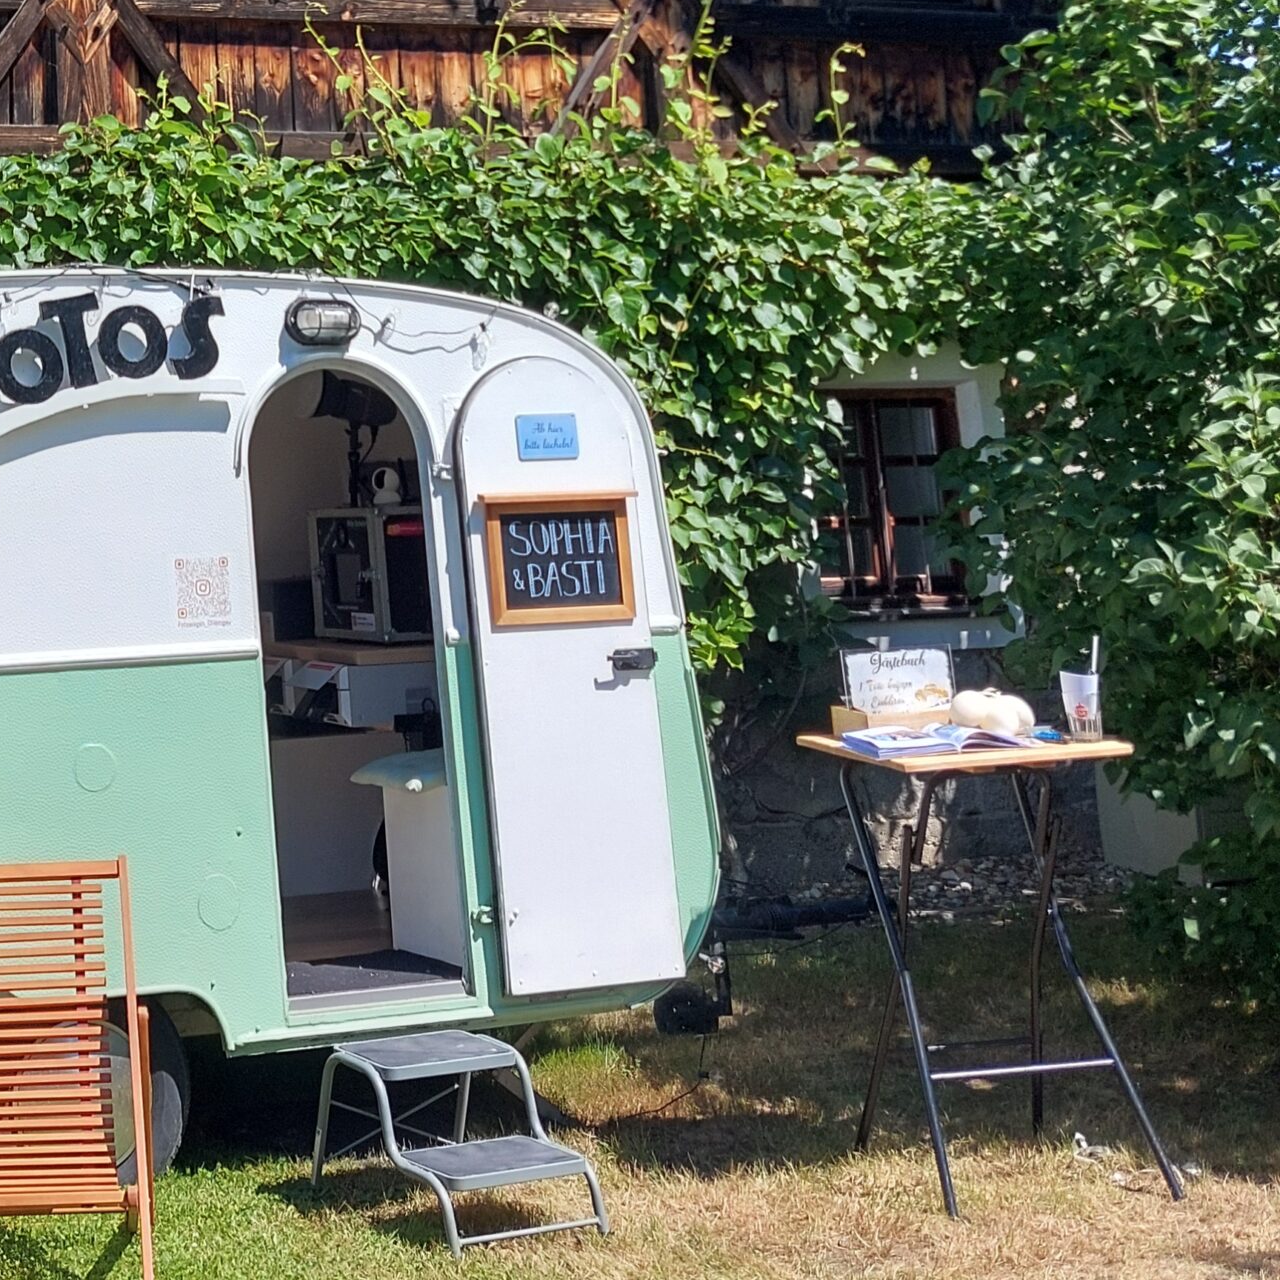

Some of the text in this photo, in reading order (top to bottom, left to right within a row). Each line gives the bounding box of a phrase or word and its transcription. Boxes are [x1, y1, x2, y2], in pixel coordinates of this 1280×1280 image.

[509, 518, 614, 556] SOPHIA
[513, 560, 606, 598] & BASTI
